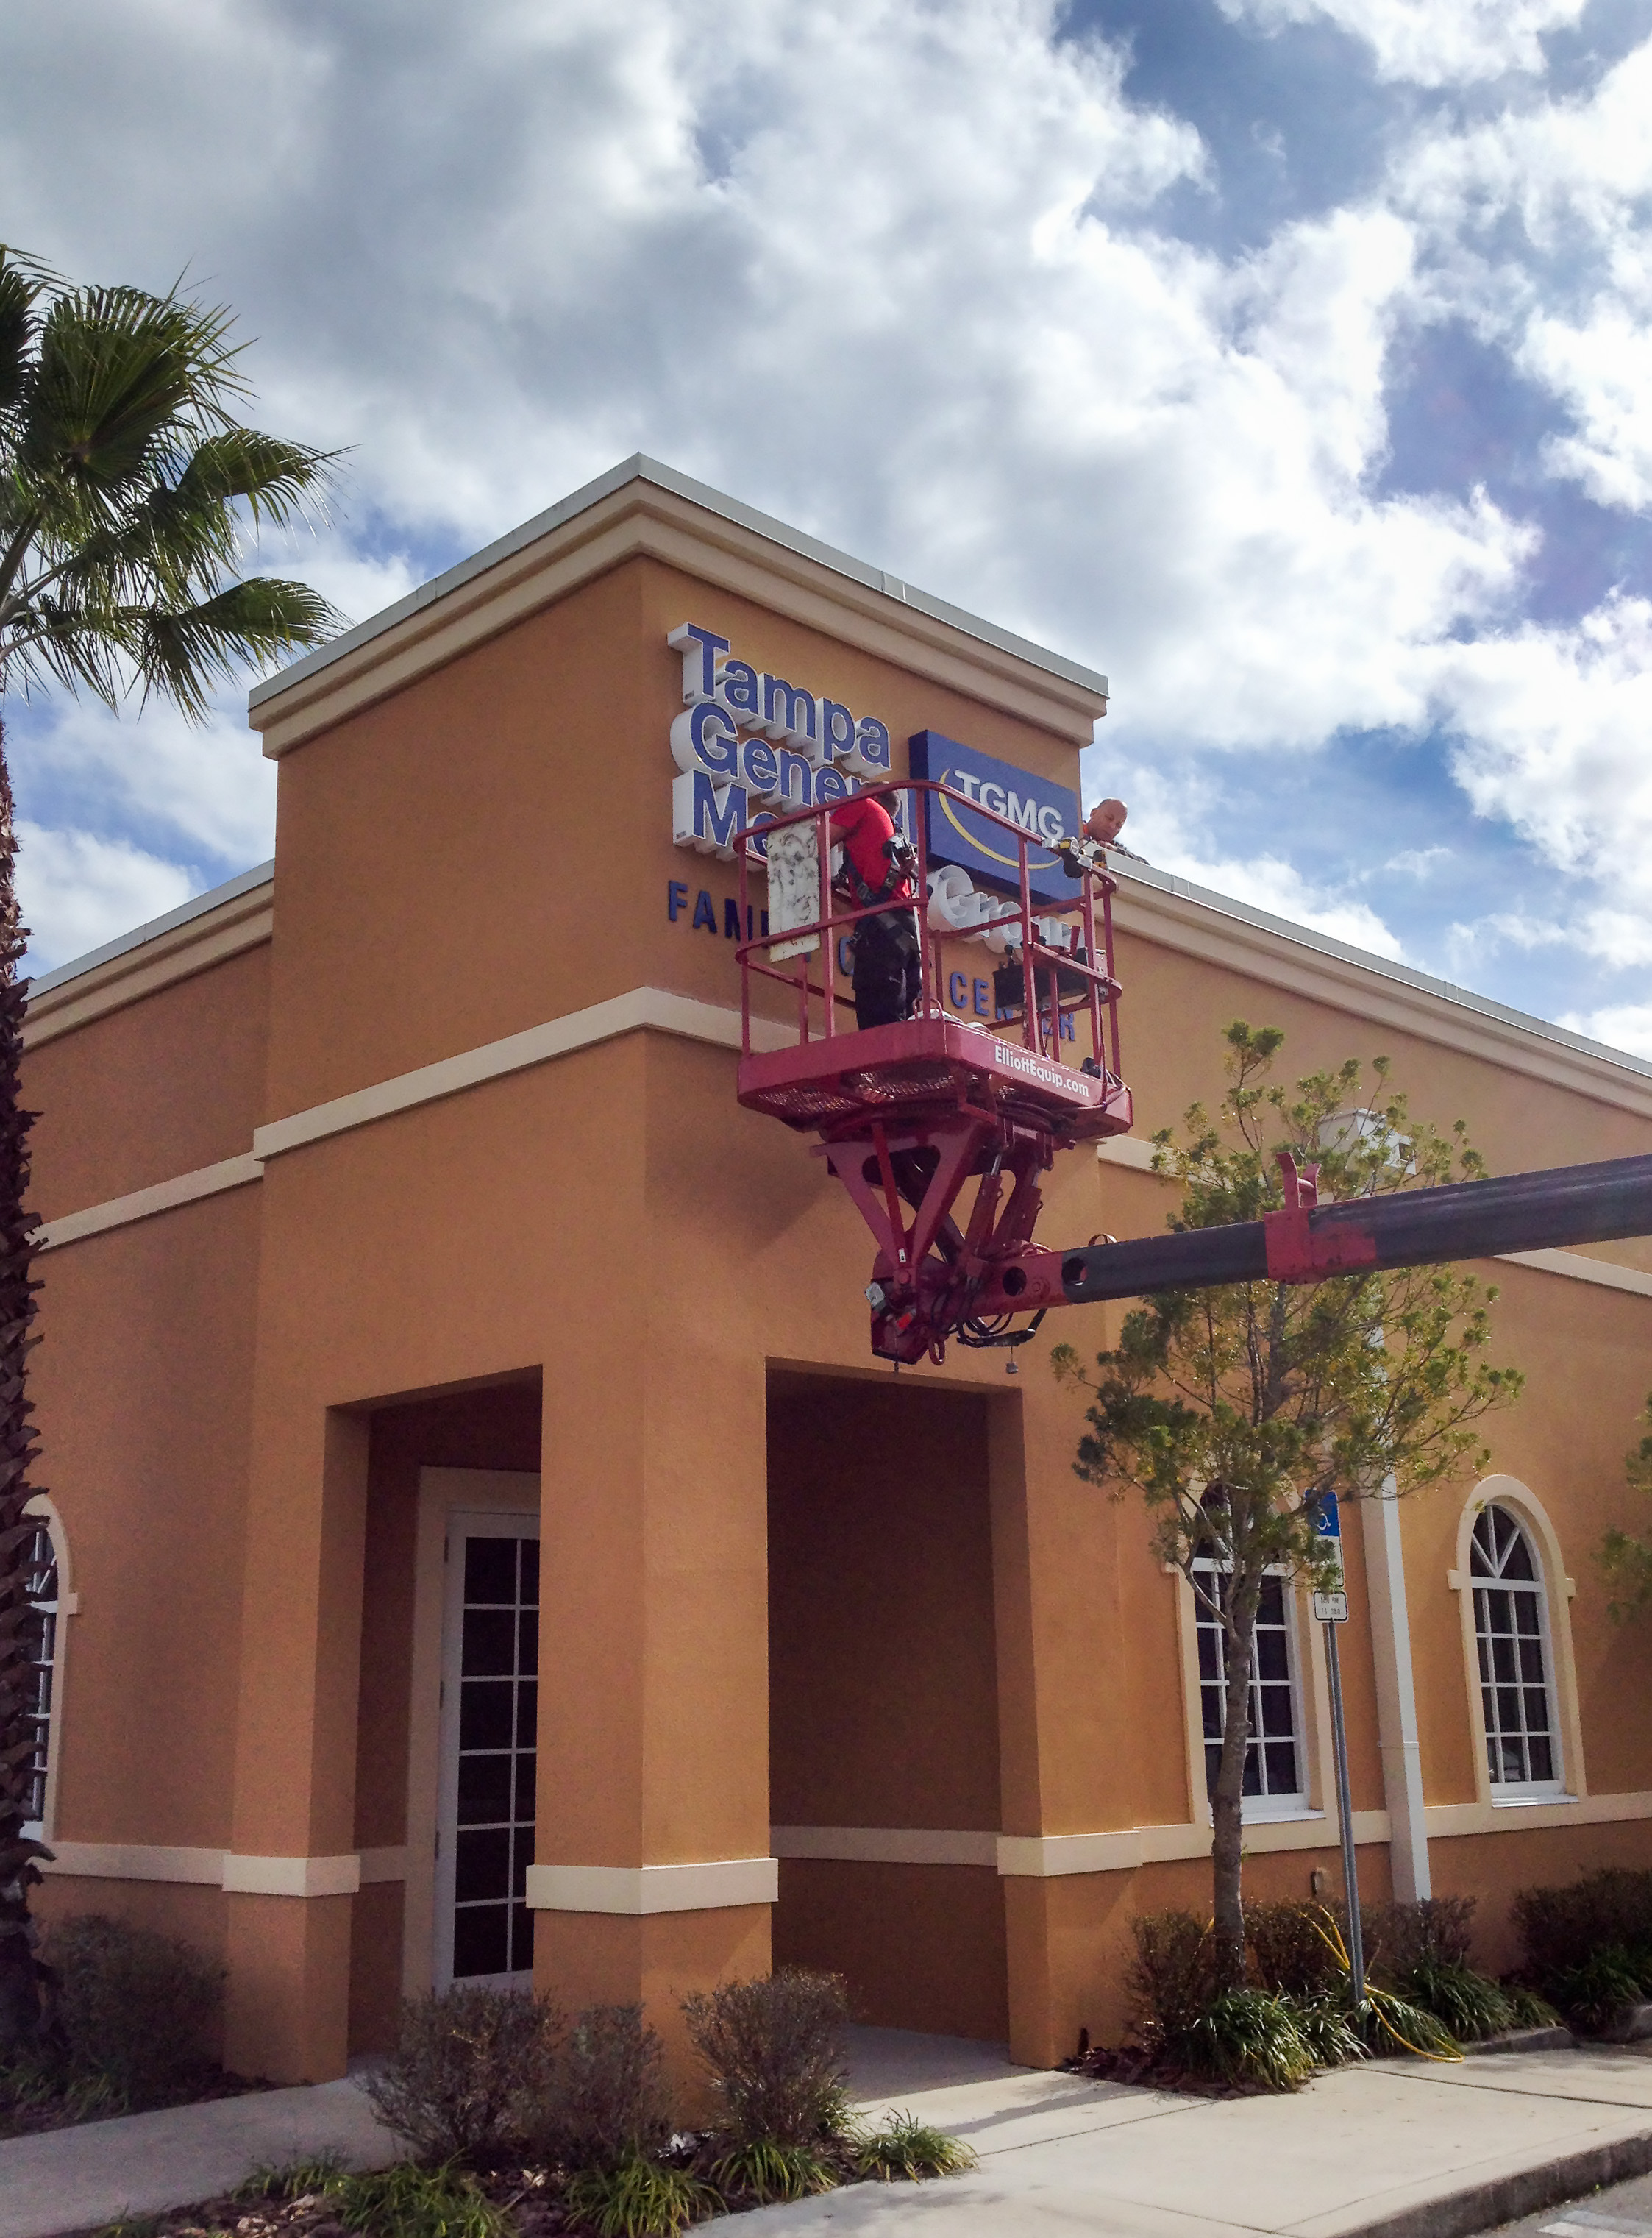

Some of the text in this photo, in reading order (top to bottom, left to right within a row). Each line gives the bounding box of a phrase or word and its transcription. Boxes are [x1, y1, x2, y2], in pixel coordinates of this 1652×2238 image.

[684, 622, 892, 771] Tampa
[688, 701, 903, 831] Gene
[954, 769, 1064, 840] TGMG
[668, 880, 811, 962] FAMI
[994, 1045, 1089, 1098] ElliottEquip.com
